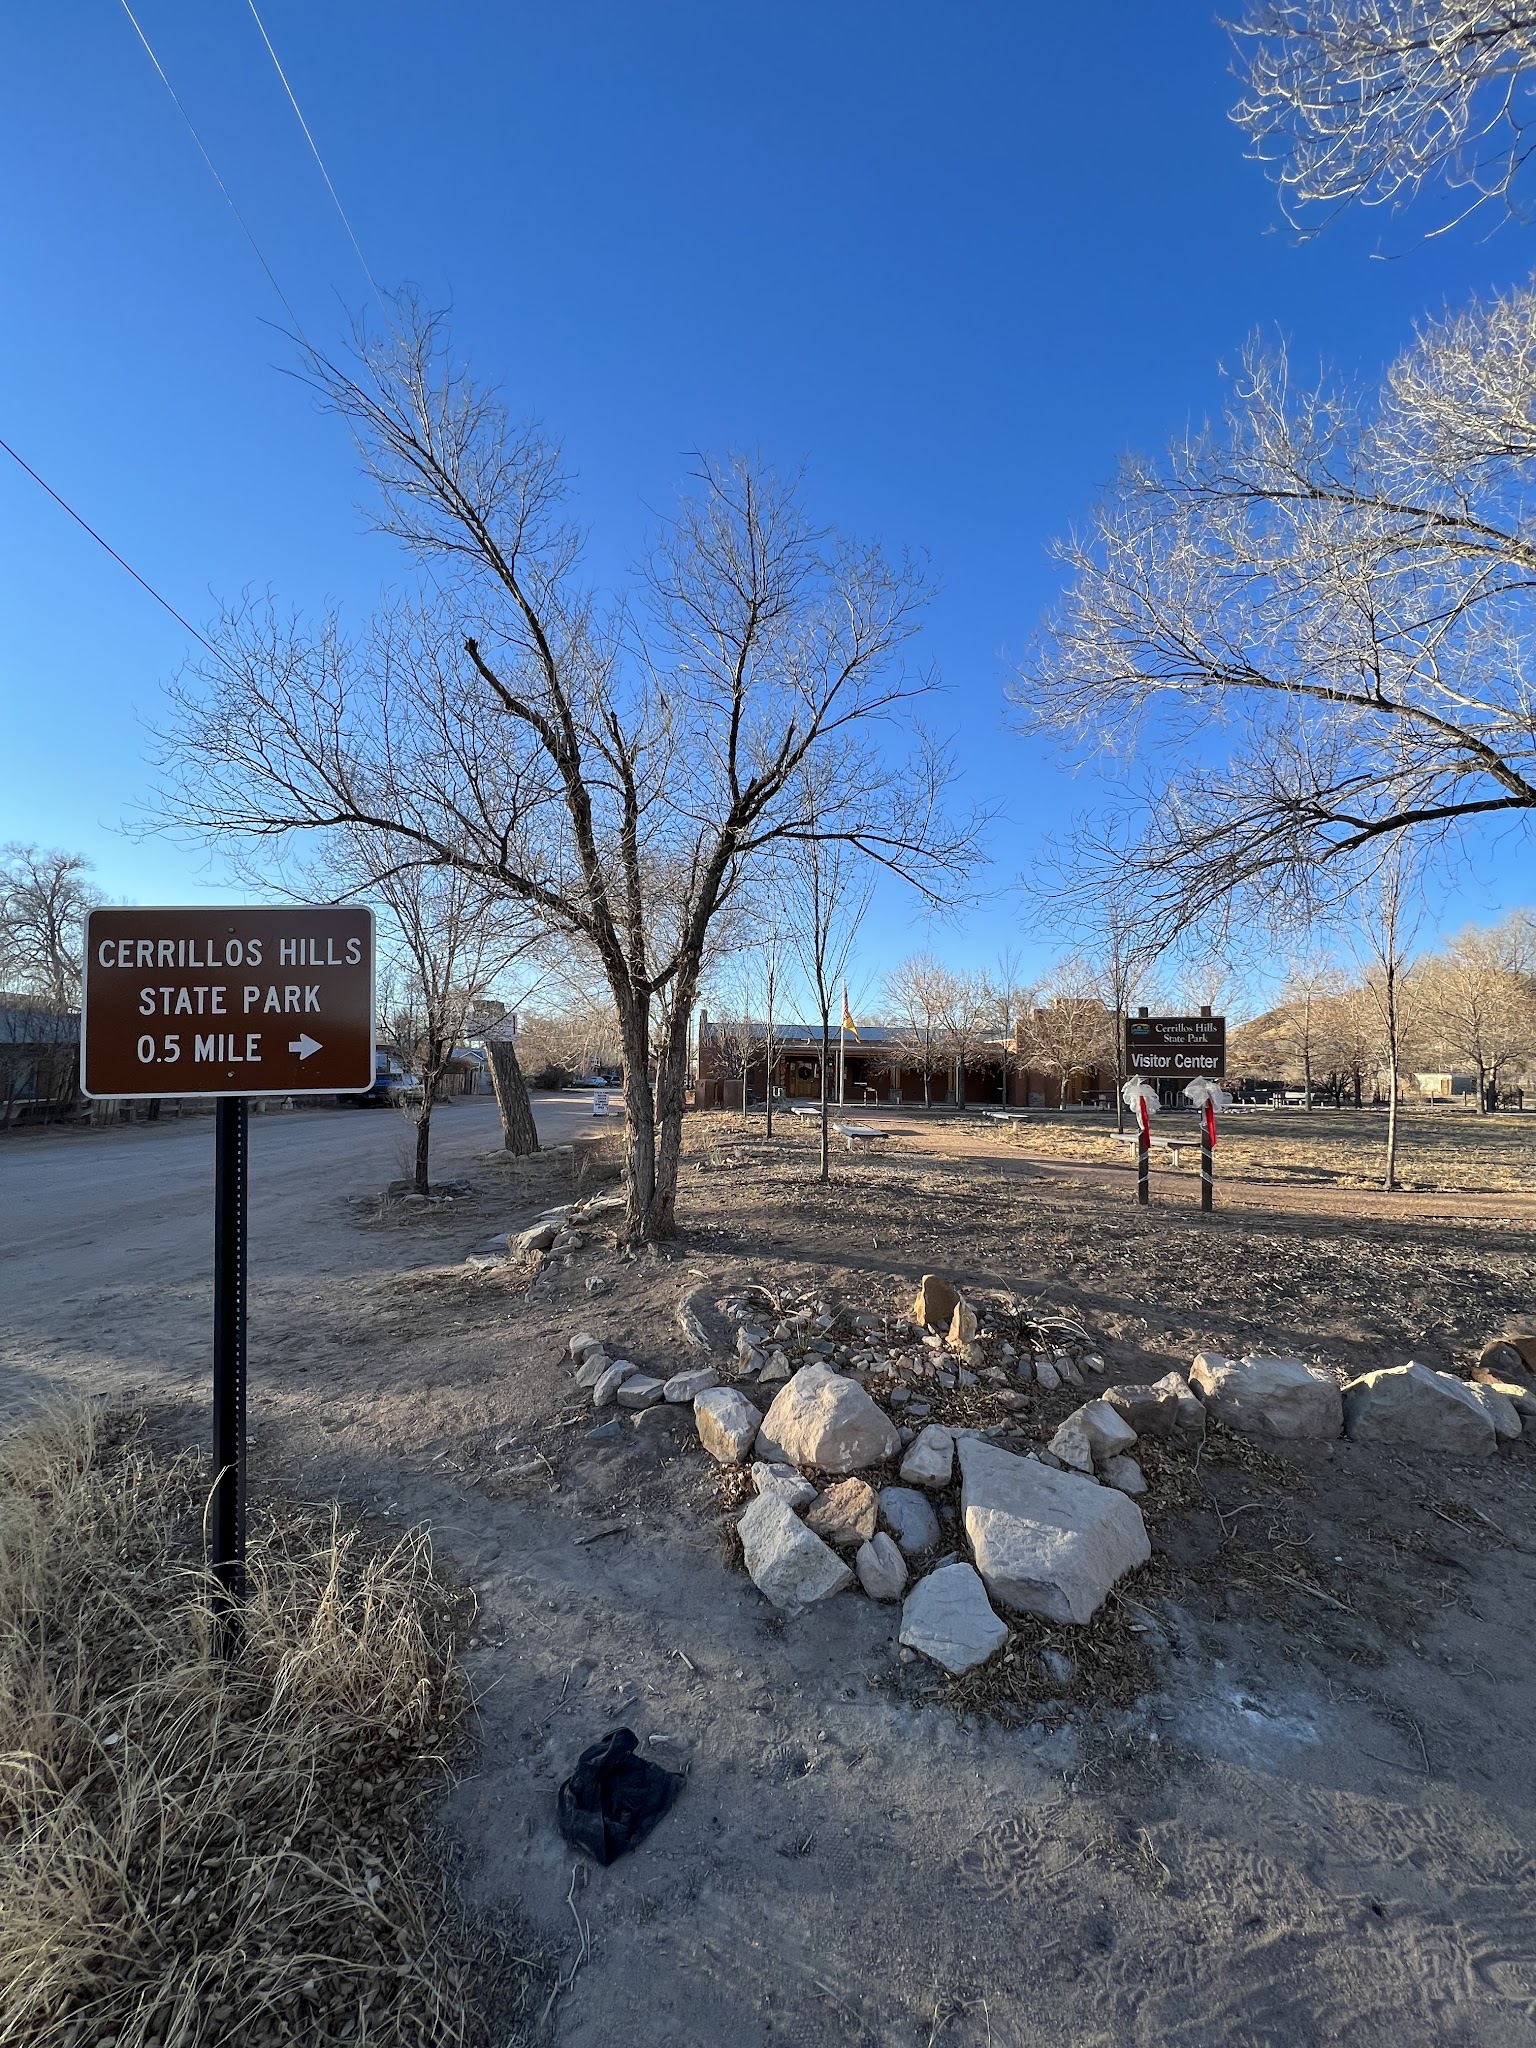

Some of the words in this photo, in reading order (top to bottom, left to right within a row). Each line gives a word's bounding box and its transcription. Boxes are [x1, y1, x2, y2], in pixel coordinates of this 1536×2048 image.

[98, 938, 263, 968] CERRILLOS
[279, 937, 361, 966] HILLS
[139, 986, 227, 1015] STATE
[243, 985, 321, 1014] PARK
[1155, 1023, 1193, 1033] Cerrillos
[1195, 1023, 1217, 1032] Hills
[1163, 1033, 1185, 1043] State
[1187, 1033, 1208, 1043] Park
[137, 1034, 180, 1063] 0.5
[194, 1033, 262, 1062] MILE
[1131, 1053, 1171, 1068] Visitor
[1174, 1053, 1218, 1069] Center
